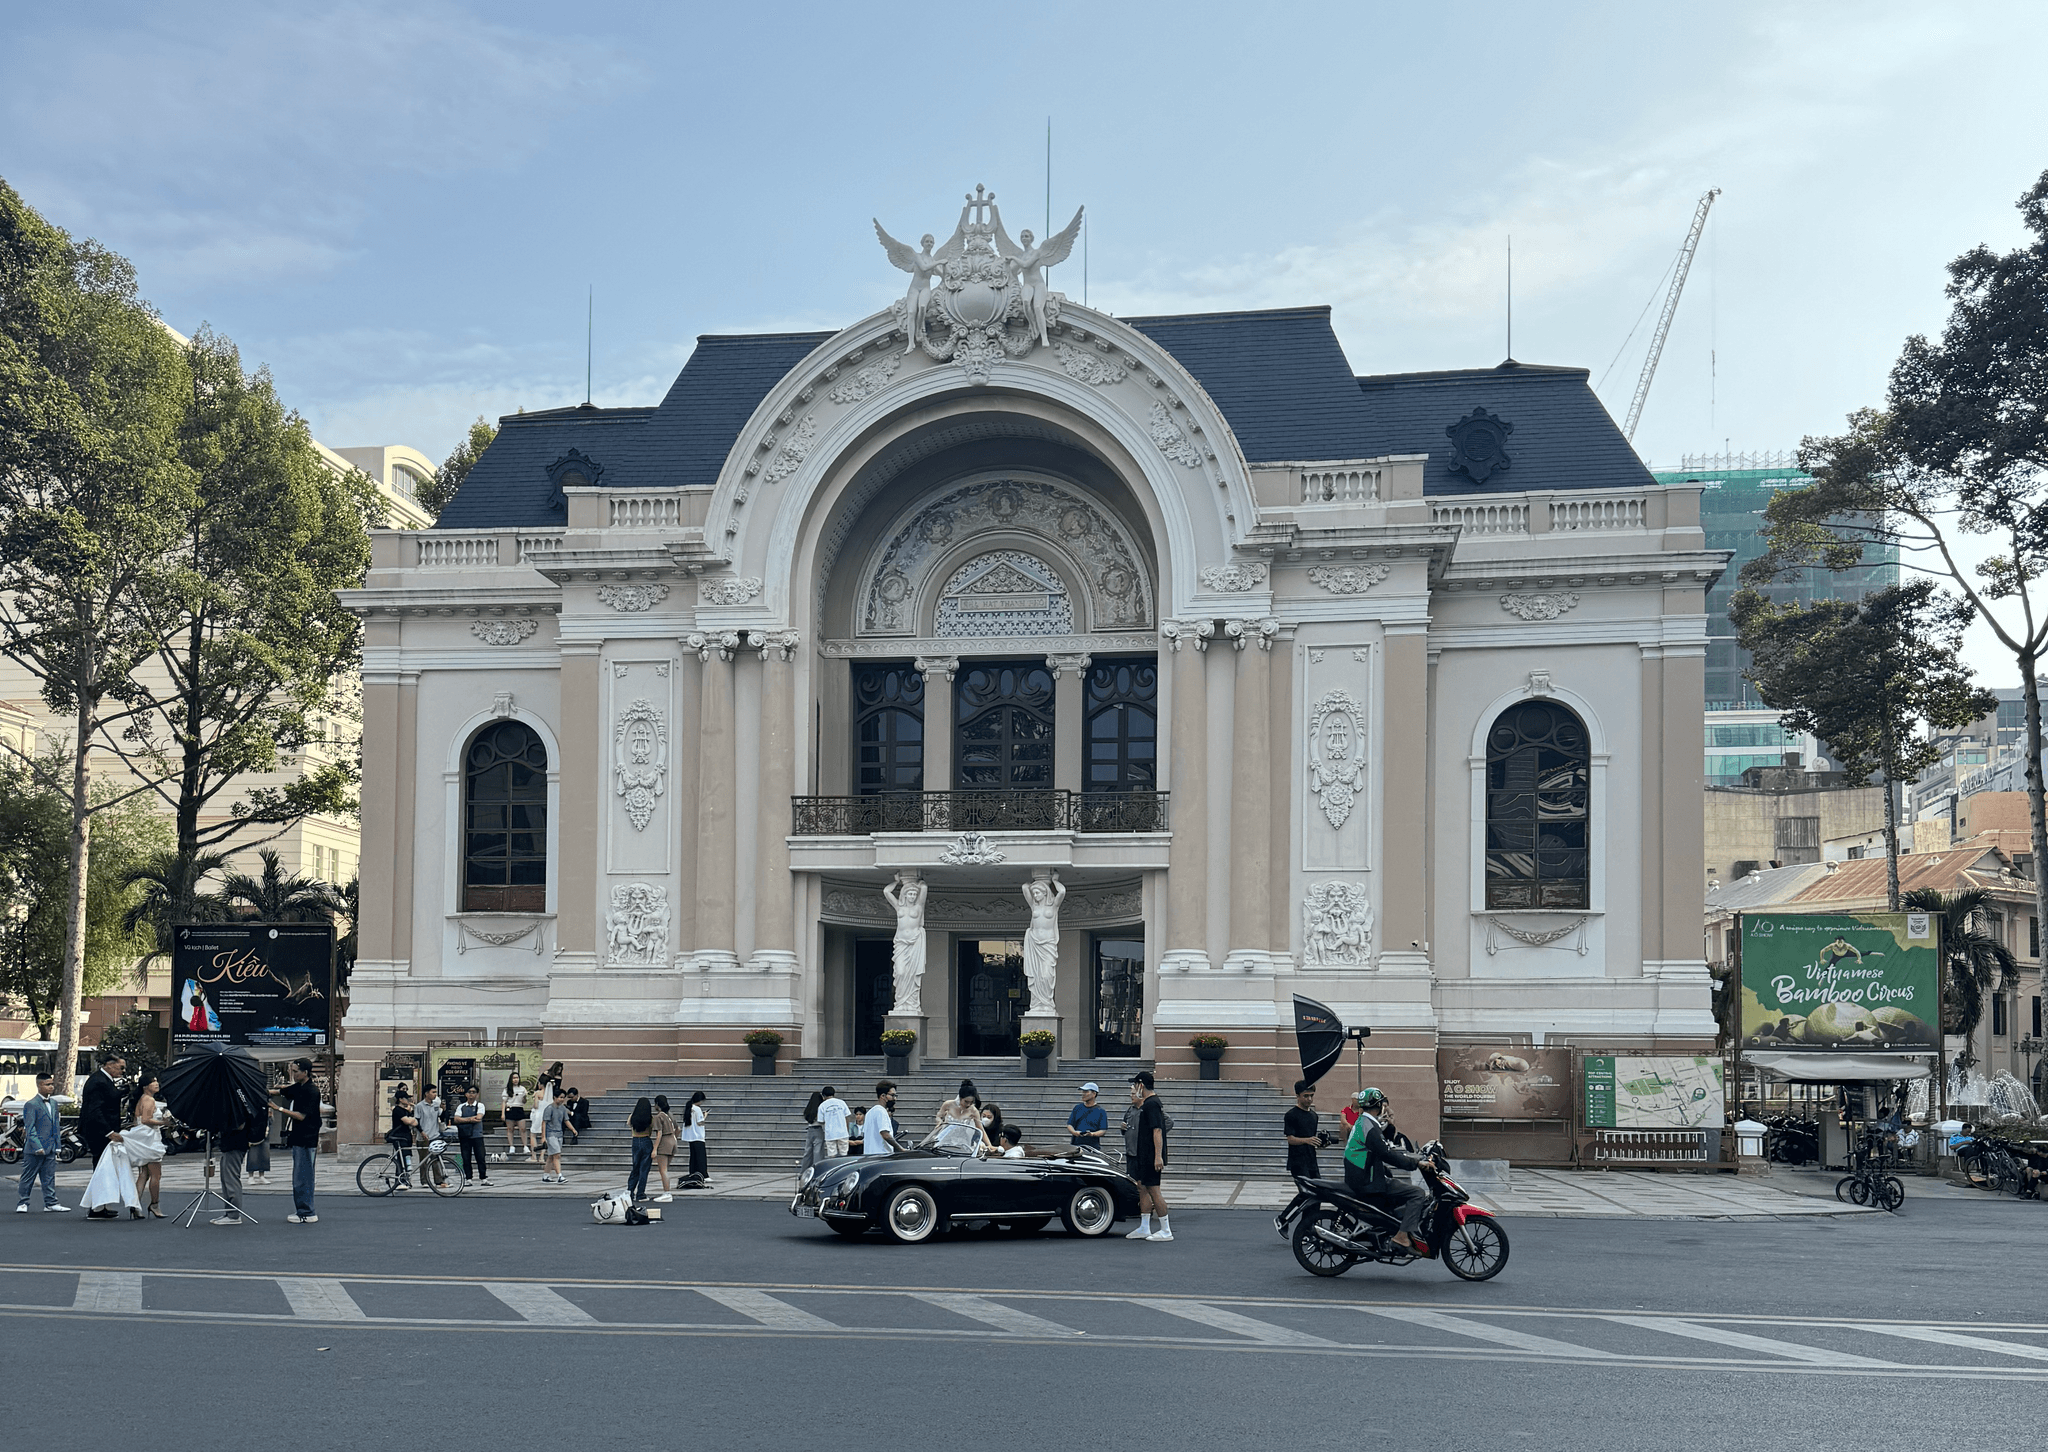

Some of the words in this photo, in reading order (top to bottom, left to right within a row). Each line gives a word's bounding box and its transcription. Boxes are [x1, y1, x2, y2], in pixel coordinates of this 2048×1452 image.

[197, 947, 269, 983] Kiều
[1802, 960, 1884, 984] Vietnamese
[1771, 975, 1864, 1004] Bamboo
[1866, 981, 1915, 1002] Circus
[1465, 1084, 1498, 1094] SHOW
